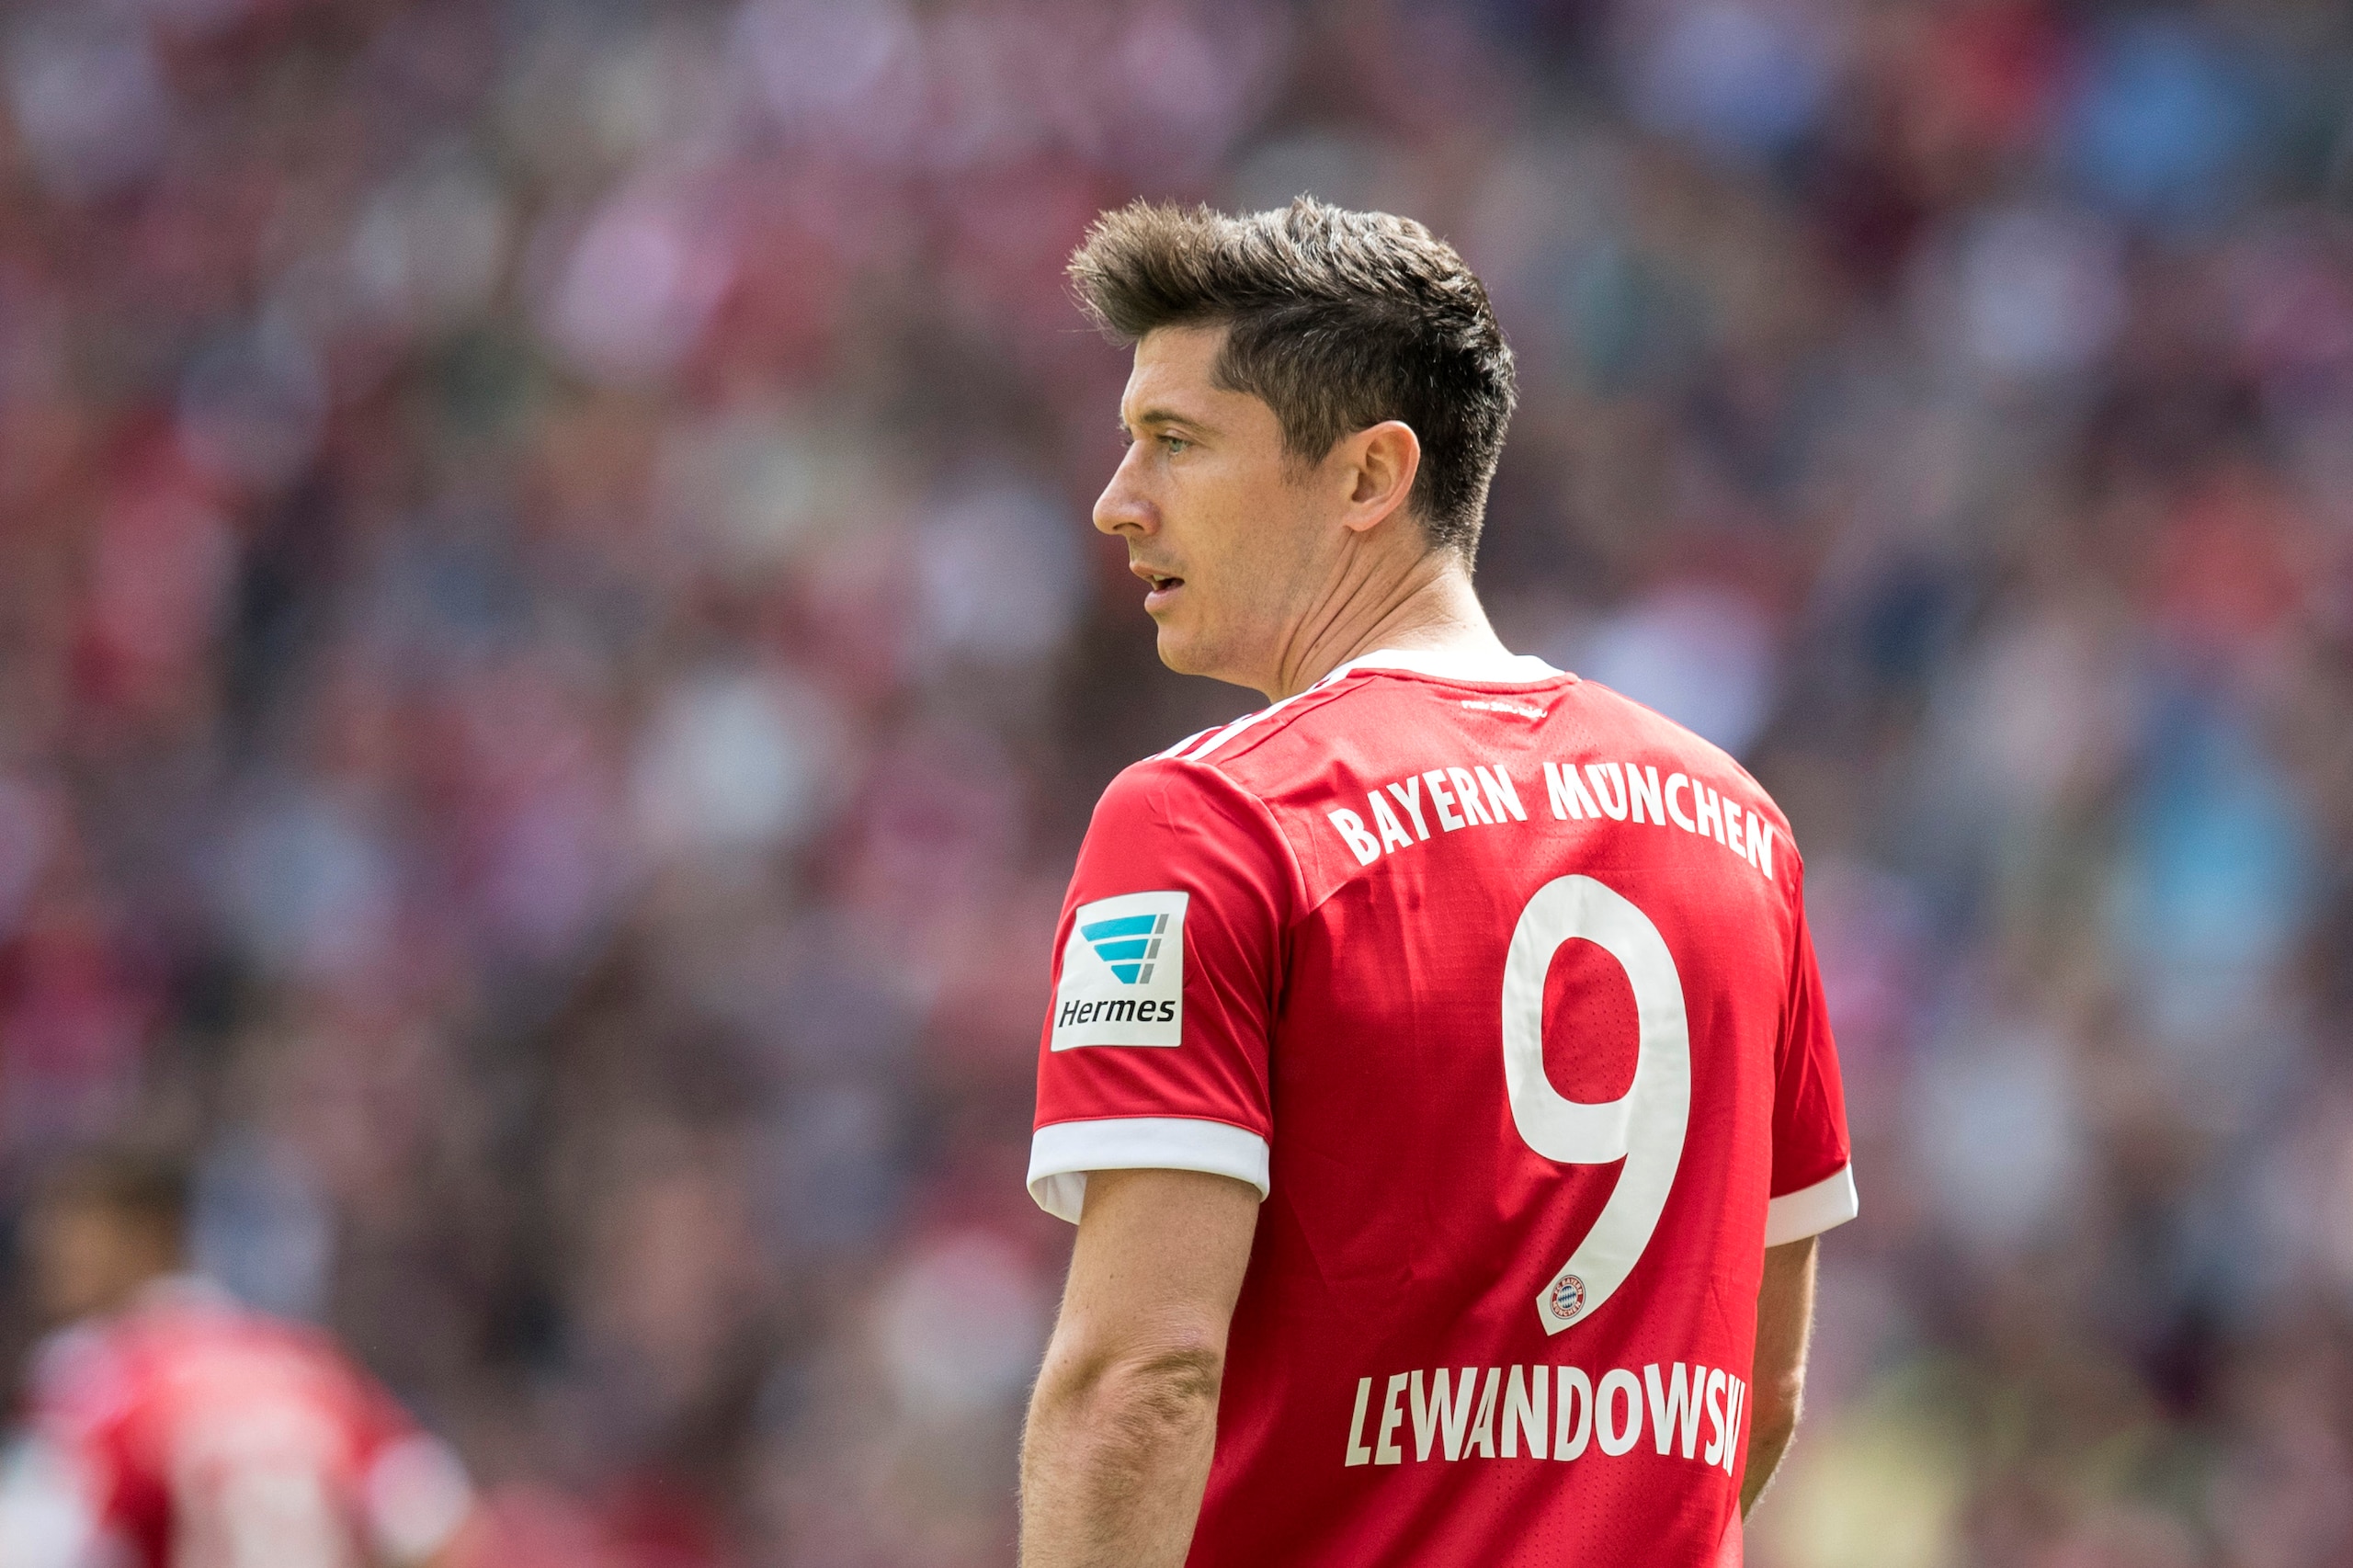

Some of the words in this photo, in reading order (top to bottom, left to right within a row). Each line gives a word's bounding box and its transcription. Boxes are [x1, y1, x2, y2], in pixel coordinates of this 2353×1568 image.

[1327, 764, 1528, 867] BAYERN
[1542, 762, 1776, 881] MÜNCHEN
[1058, 999, 1176, 1028] Hermes
[1501, 873, 1692, 1337] 9
